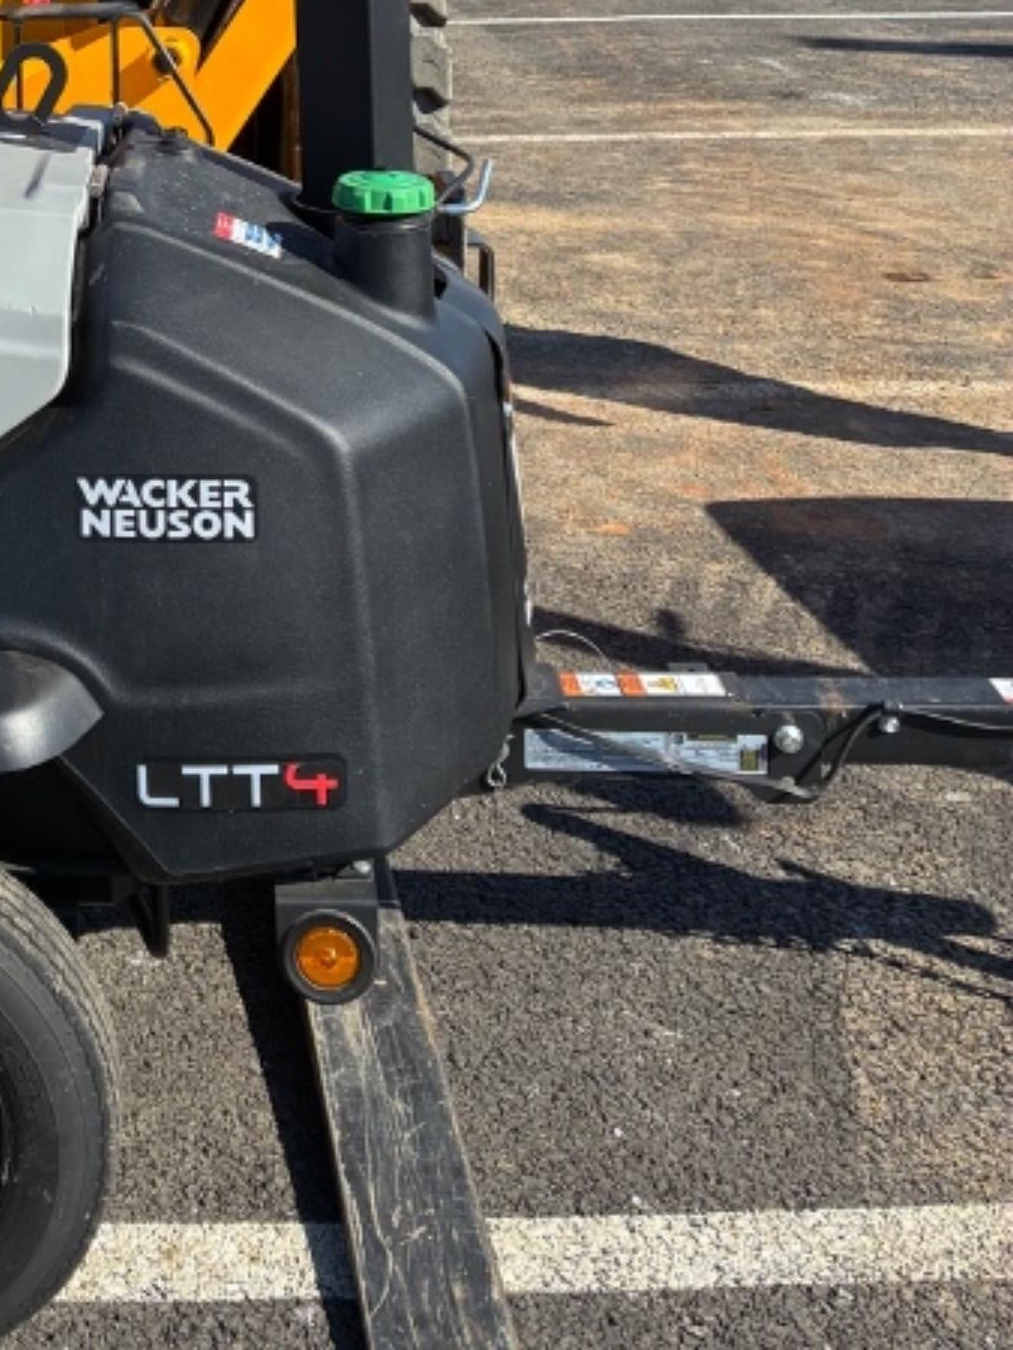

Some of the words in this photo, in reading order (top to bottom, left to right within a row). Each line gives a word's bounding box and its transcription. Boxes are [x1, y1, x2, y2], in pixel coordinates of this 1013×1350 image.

[77, 478, 254, 508] WACKER
[81, 509, 255, 539] NEUSON
[137, 762, 340, 808] LTT4
